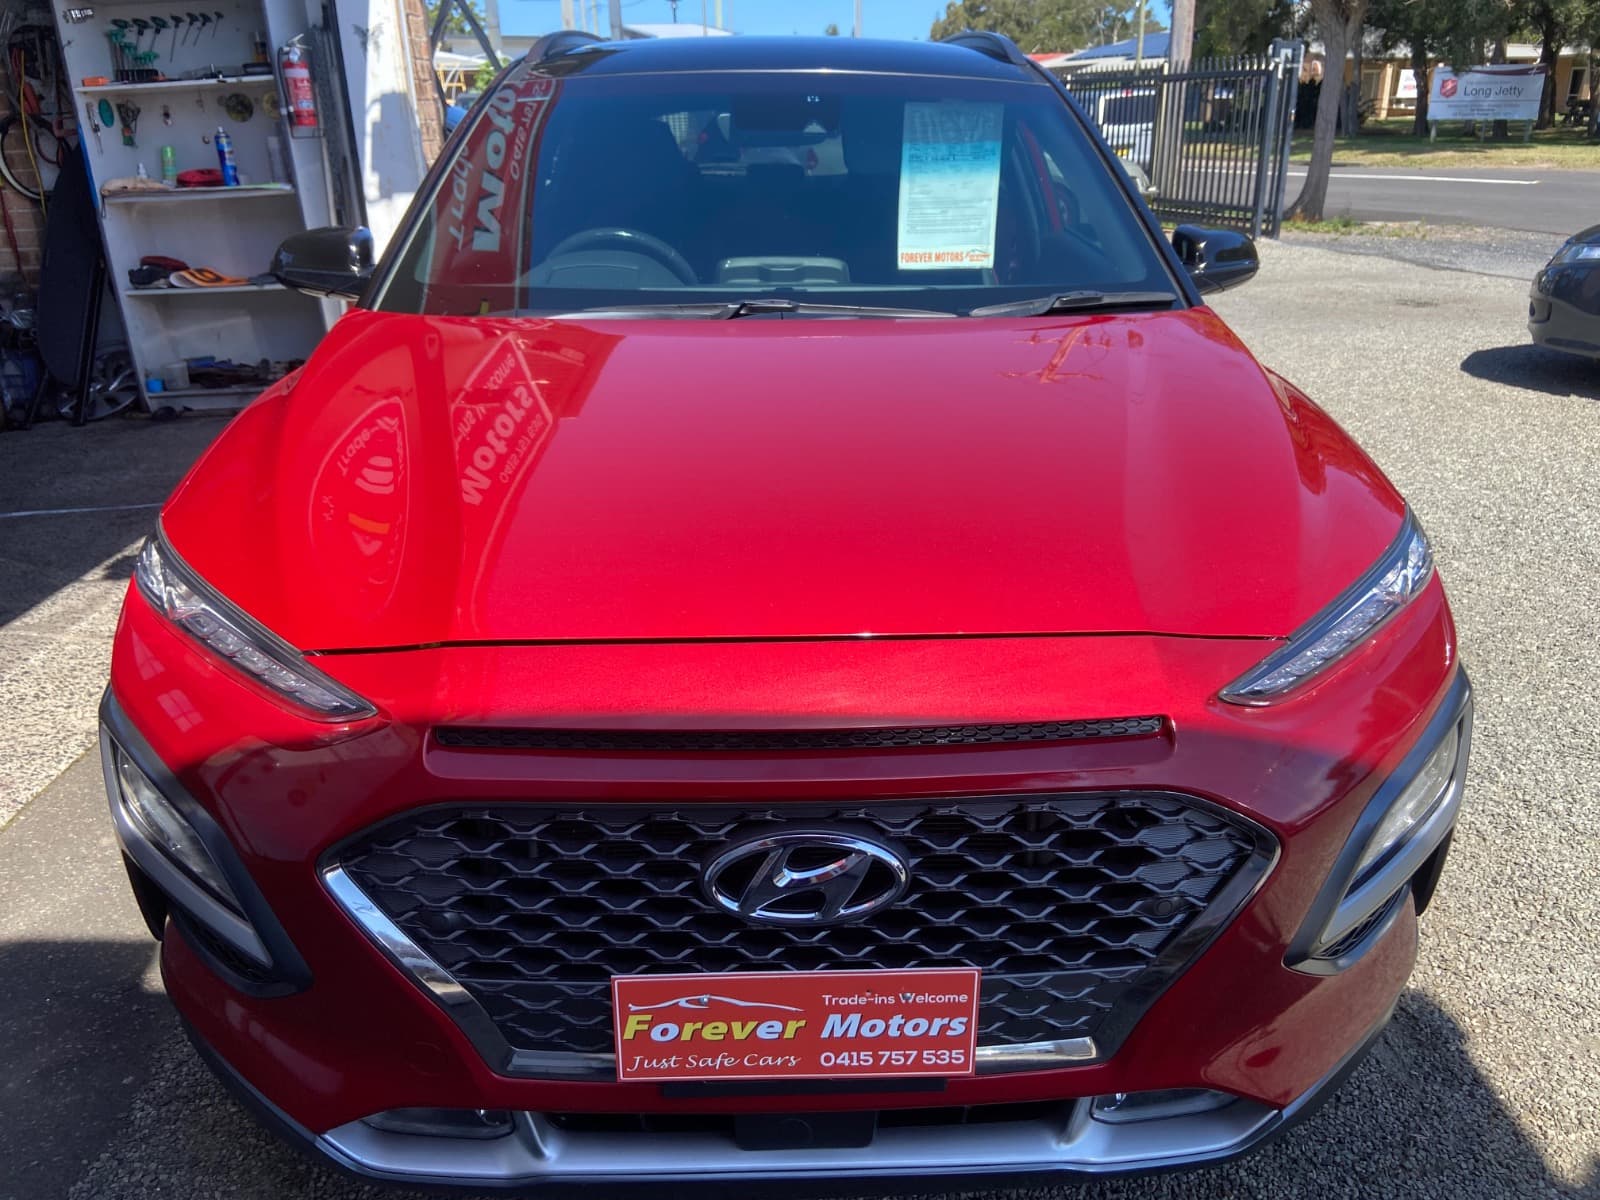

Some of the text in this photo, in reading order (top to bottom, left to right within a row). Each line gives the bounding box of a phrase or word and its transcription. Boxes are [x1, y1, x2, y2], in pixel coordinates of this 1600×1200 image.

[1464, 86, 1524, 98] Long Jetty
[901, 252, 932, 264] FOREVER
[935, 251, 963, 263] MOTORS
[822, 992, 968, 1006] Trade-ins Welcome
[623, 1013, 968, 1042] Forever Motors
[627, 1053, 801, 1072] Just Safe Cars
[820, 1050, 965, 1067] 0415 757 535
